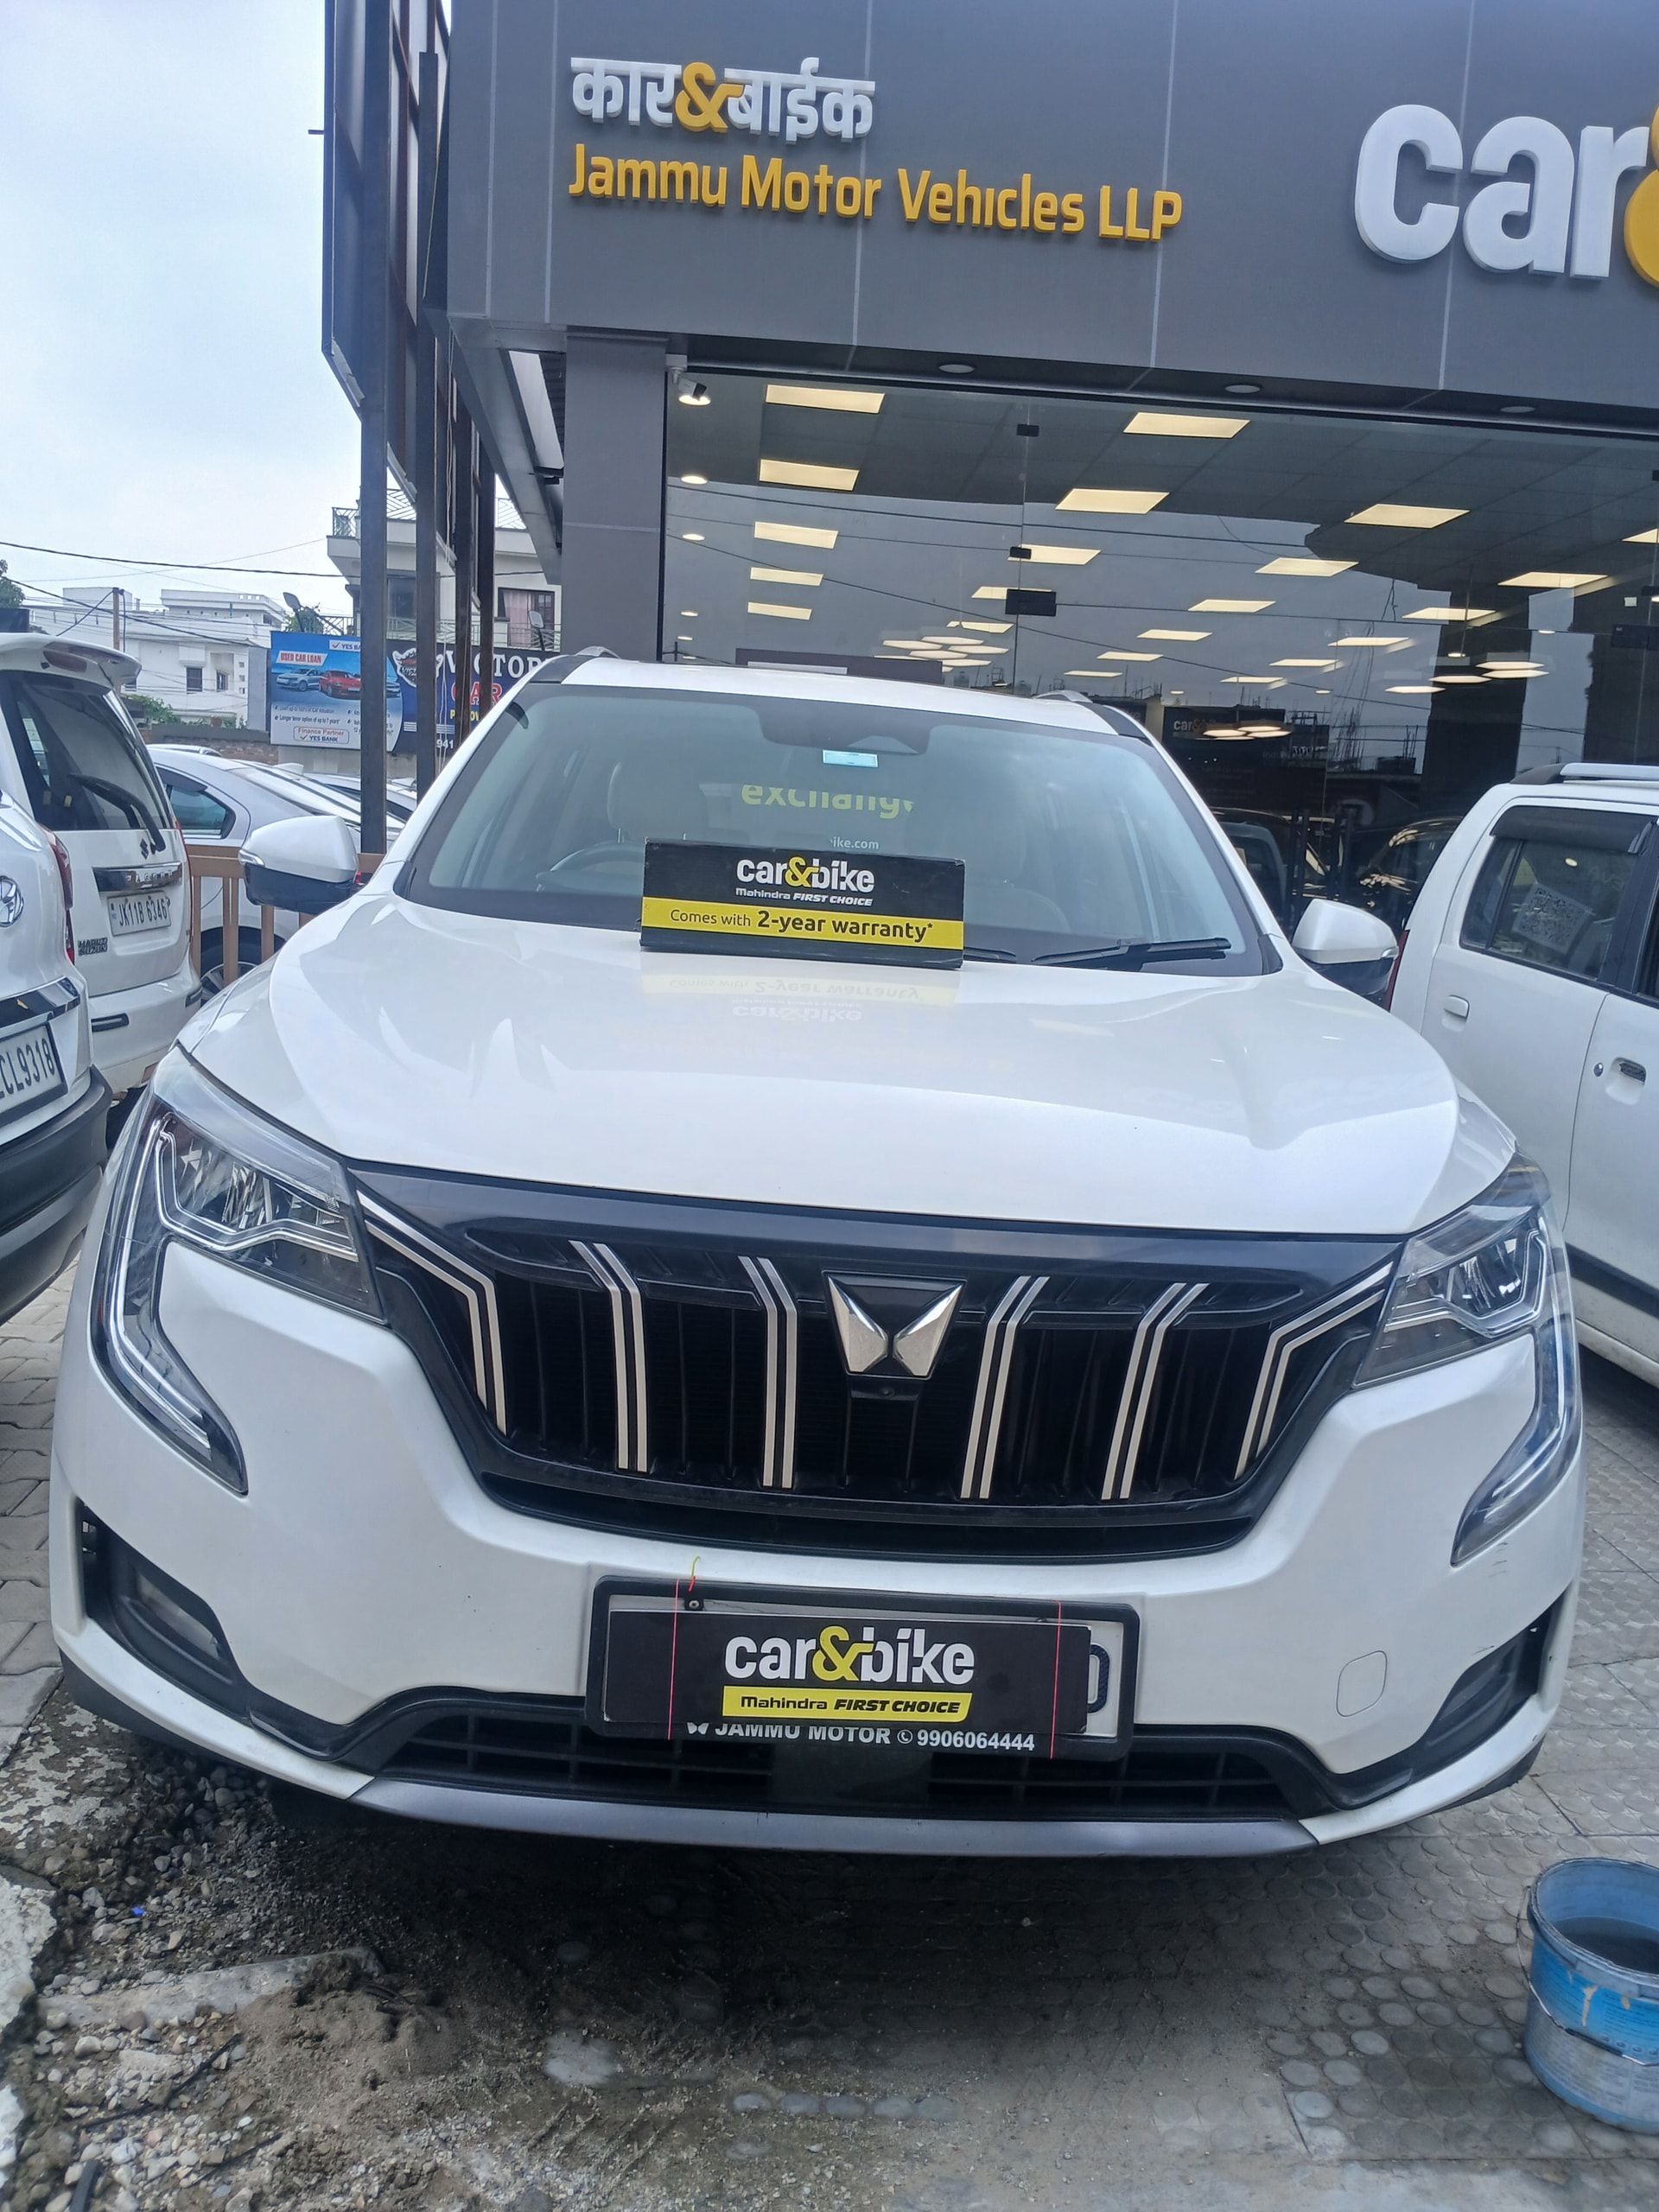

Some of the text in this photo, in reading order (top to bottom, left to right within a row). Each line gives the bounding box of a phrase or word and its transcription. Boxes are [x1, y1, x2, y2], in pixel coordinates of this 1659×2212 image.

[569, 143, 728, 206] Jammu
[741, 155, 881, 219] Motor
[1097, 185, 1183, 242] LLP
[280, 652, 321, 664] USED CAR LOAN
[741, 784, 915, 819] exchang
[830, 836, 880, 850] ike.com
[736, 855, 875, 893] car&bike
[735, 887, 874, 906] Mahindra FIRST CHOICE
[671, 908, 717, 925] Comes
[721, 912, 751, 927] with
[757, 910, 826, 933] 2-year
[724, 1625, 975, 1686] car&bike
[741, 1696, 960, 1713] Mahindra FIRST CHOICE
[715, 1724, 1035, 1751] JAMMU MOTOR 9906064444
